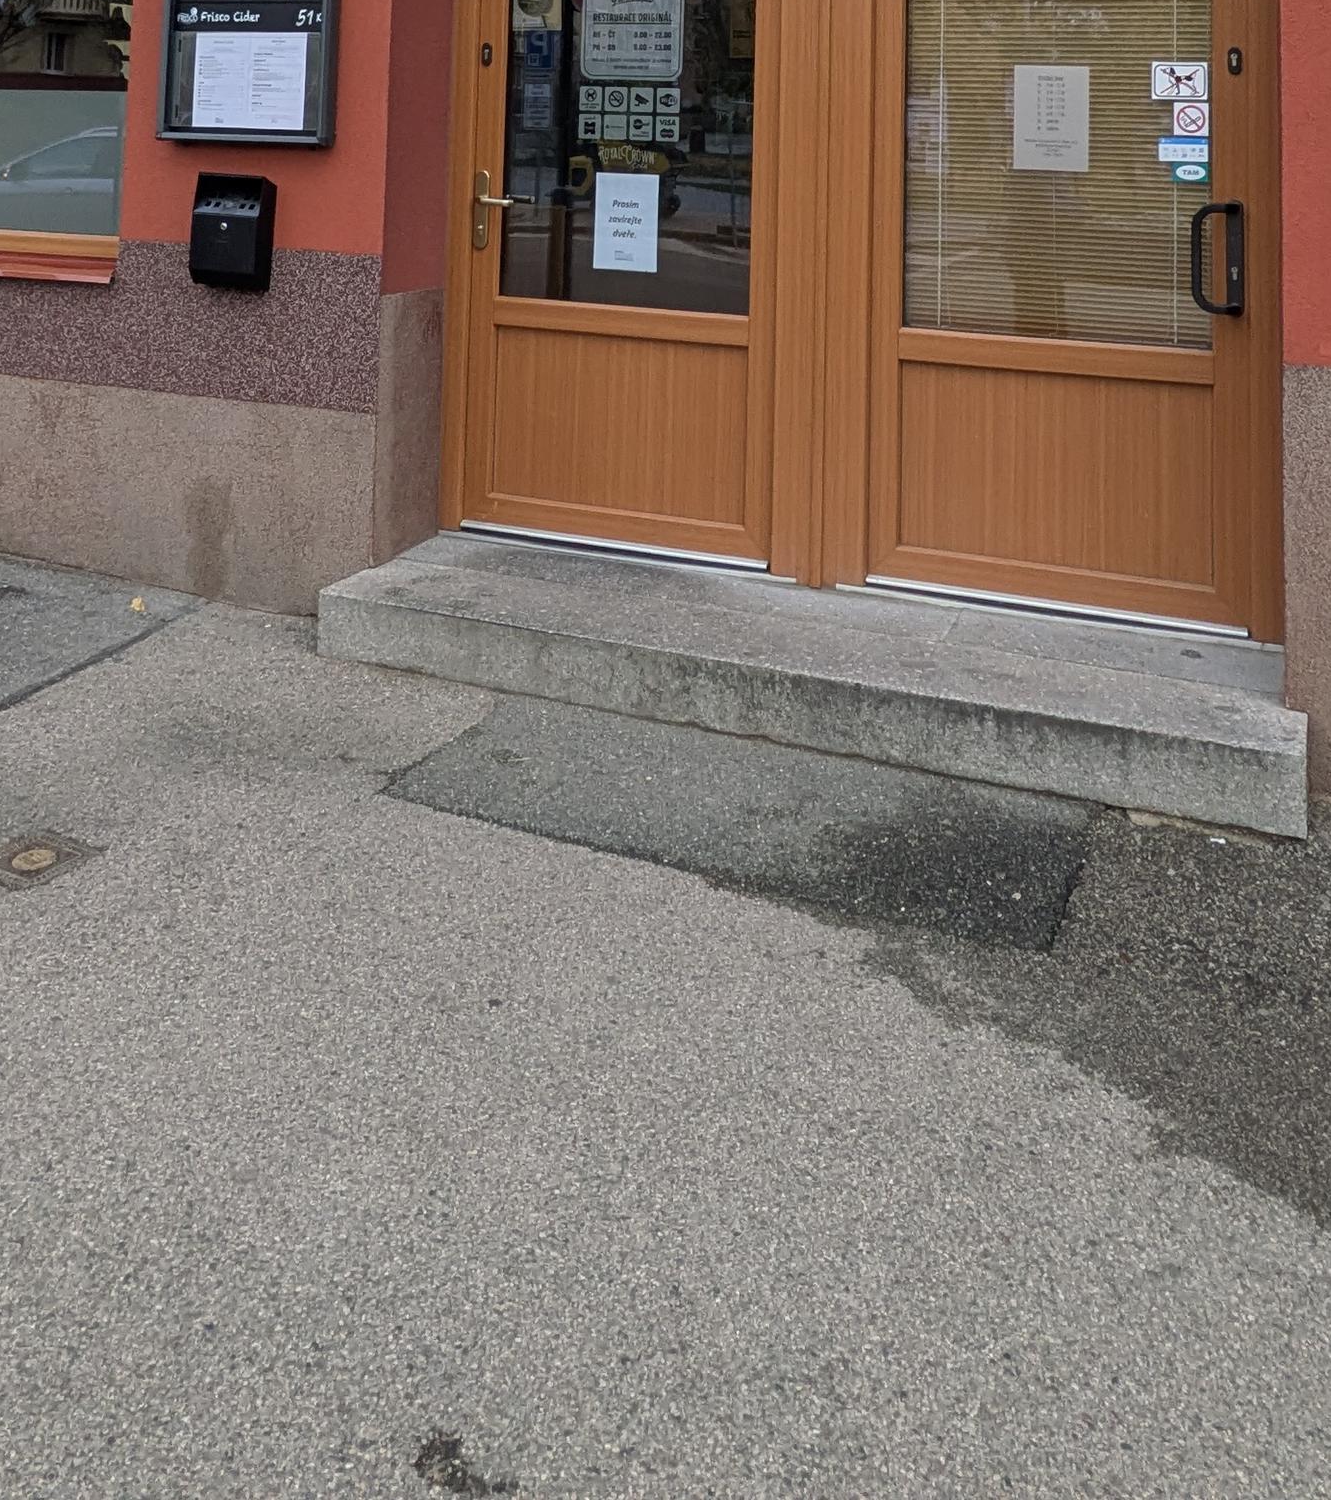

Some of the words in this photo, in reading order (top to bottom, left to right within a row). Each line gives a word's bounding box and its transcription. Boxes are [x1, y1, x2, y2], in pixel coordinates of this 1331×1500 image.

[200, 11, 230, 23] Frisco
[233, 10, 261, 23] Cider
[295, 8, 315, 27] 51
[638, 10, 673, 22] ORIGINÁL
